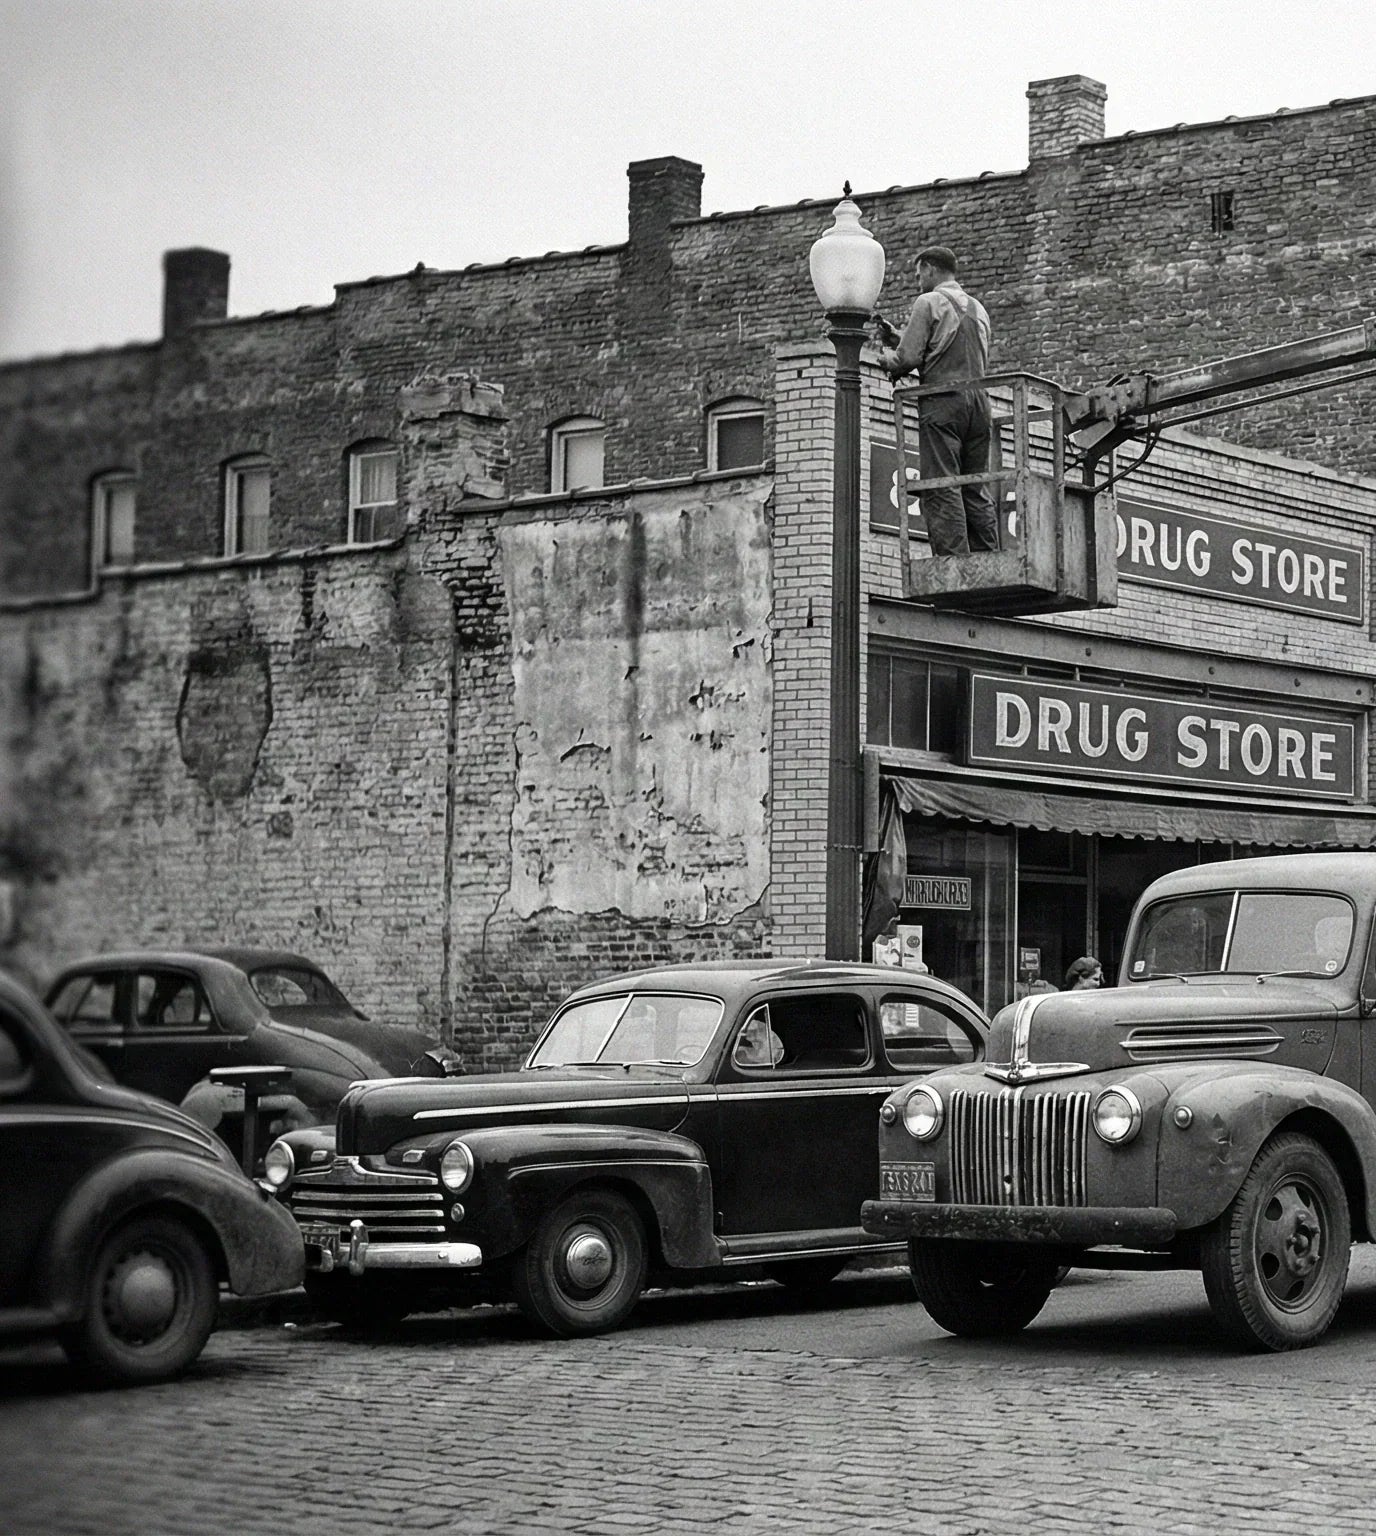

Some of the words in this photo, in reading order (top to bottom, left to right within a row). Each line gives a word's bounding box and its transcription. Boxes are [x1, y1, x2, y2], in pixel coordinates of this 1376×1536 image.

[1231, 537, 1348, 603] STORE
[995, 691, 1149, 762] DRUG
[1177, 715, 1336, 782] STORE
